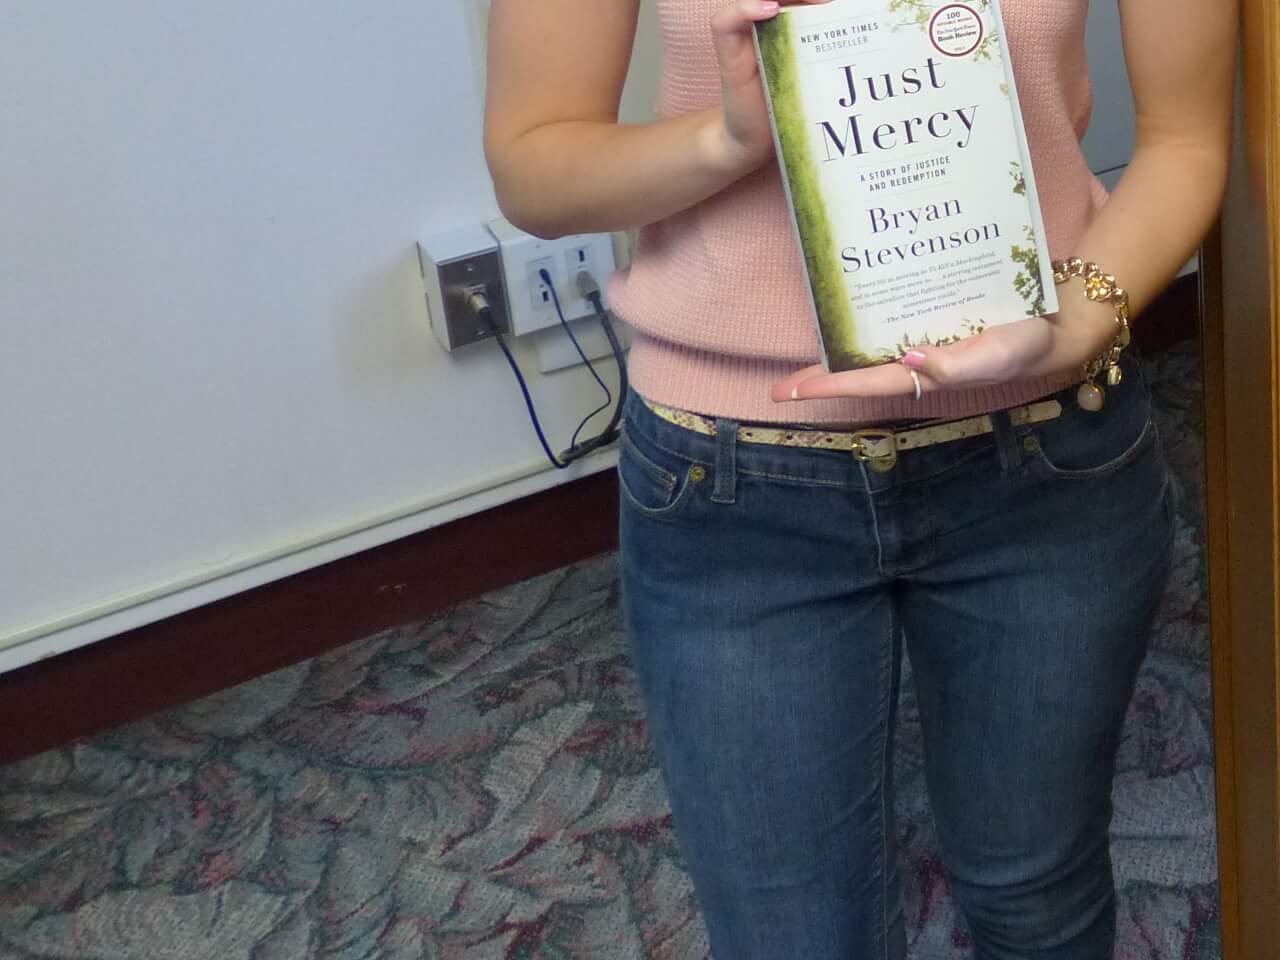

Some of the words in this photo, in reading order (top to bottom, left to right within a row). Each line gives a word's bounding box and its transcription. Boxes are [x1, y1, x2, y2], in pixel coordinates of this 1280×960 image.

[946, 11, 960, 19] 100
[800, 32, 821, 44] NEW
[824, 27, 847, 40] YORK
[850, 22, 879, 34] TIMES
[815, 35, 869, 53] BESTSELLER
[838, 58, 946, 108] Just
[815, 104, 980, 163] Mercy
[860, 174, 866, 182] A
[868, 168, 897, 181] STORY
[901, 164, 911, 174] OF
[915, 155, 951, 170] JUSTICE
[869, 181, 886, 192] AND
[890, 168, 946, 188] REDEMPTION
[866, 198, 964, 235] Bryan
[840, 221, 1003, 274] Stevenson
